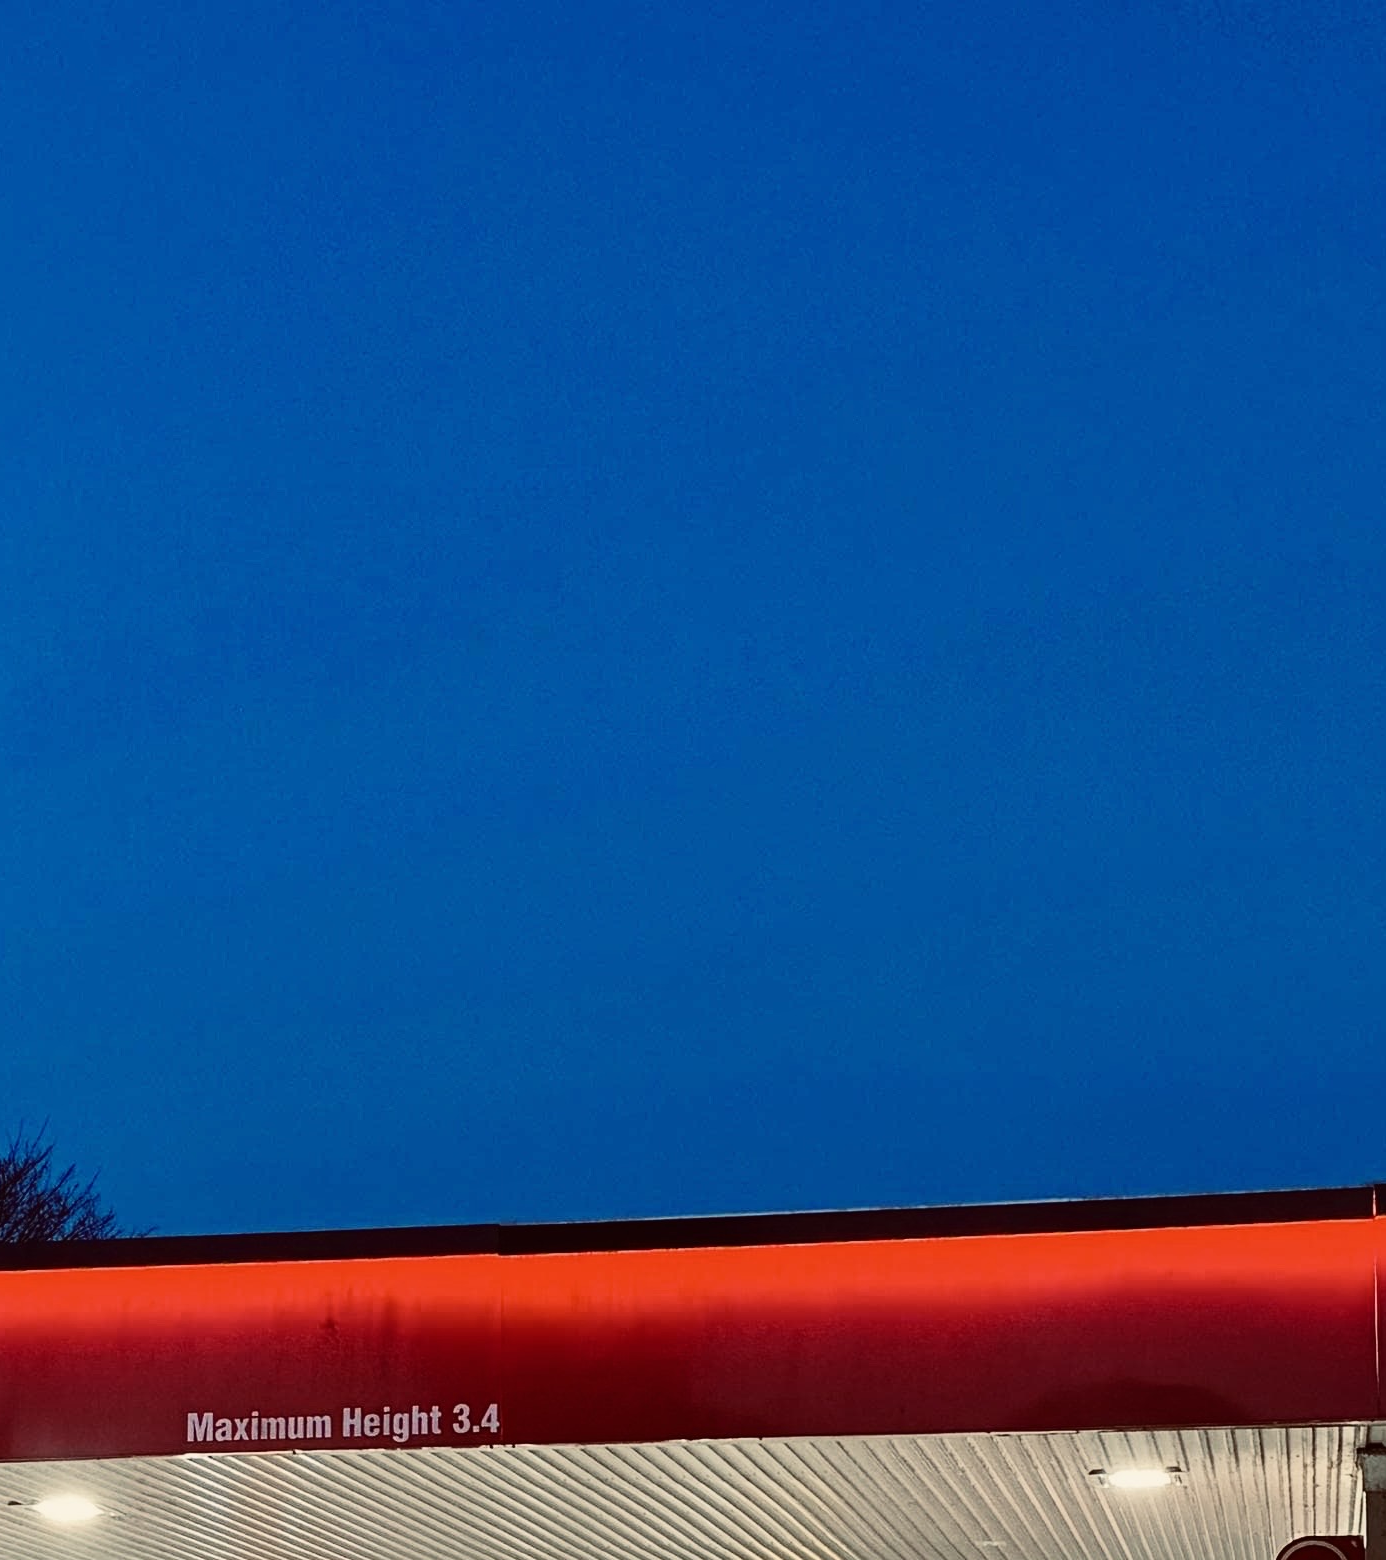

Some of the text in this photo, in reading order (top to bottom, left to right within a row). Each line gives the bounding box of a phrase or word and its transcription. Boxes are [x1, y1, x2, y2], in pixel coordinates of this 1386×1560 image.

[186, 1403, 500, 1443] Maximum Height 3.4
